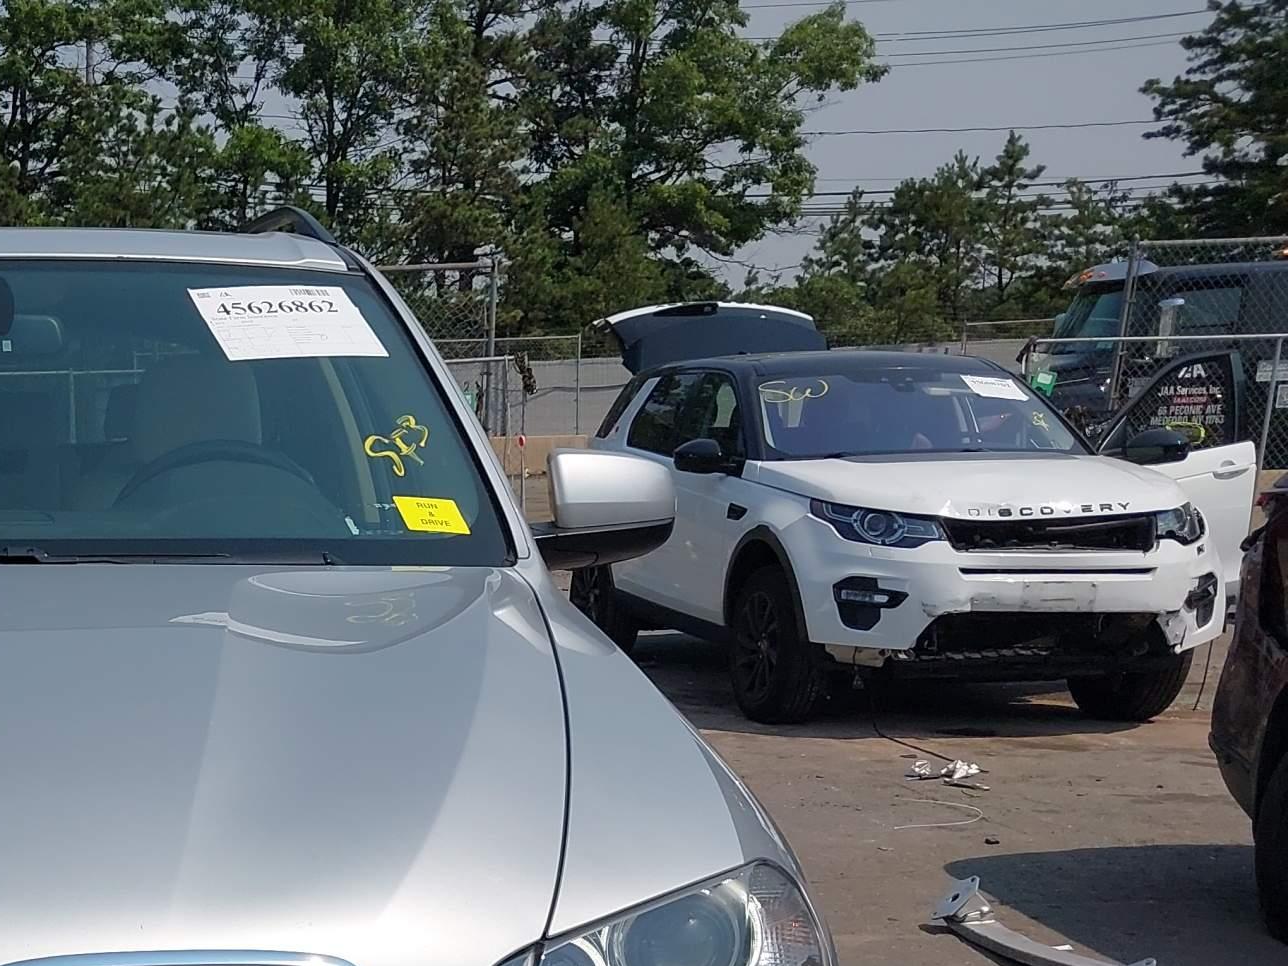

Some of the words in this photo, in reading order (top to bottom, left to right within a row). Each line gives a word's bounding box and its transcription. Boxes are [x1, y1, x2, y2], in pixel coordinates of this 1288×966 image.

[216, 300, 339, 316] 45626862
[415, 501, 439, 511] RUN
[420, 518, 452, 528] DRIVE
